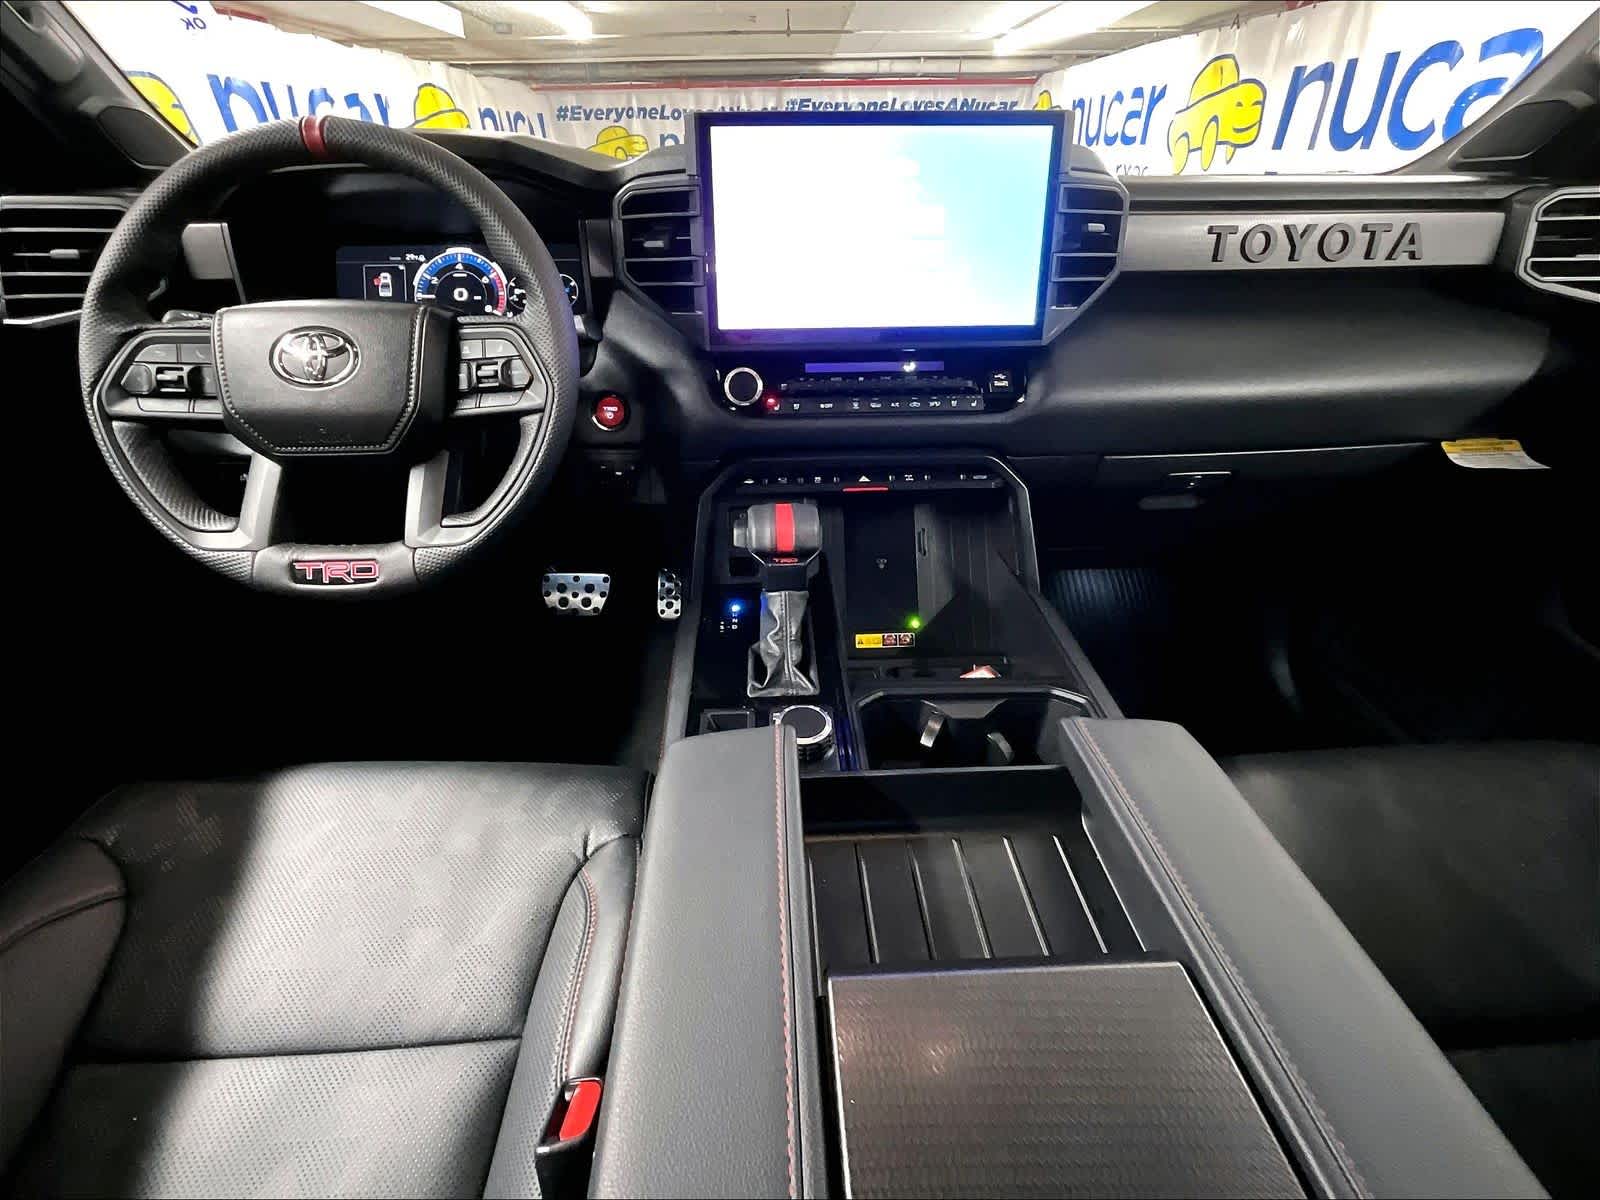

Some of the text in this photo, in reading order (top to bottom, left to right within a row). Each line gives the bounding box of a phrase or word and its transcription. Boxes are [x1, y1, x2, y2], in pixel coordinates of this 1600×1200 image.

[1072, 84, 1168, 146] nucar
[1207, 223, 1423, 263] TOYOTA
[293, 561, 379, 584] TRD
